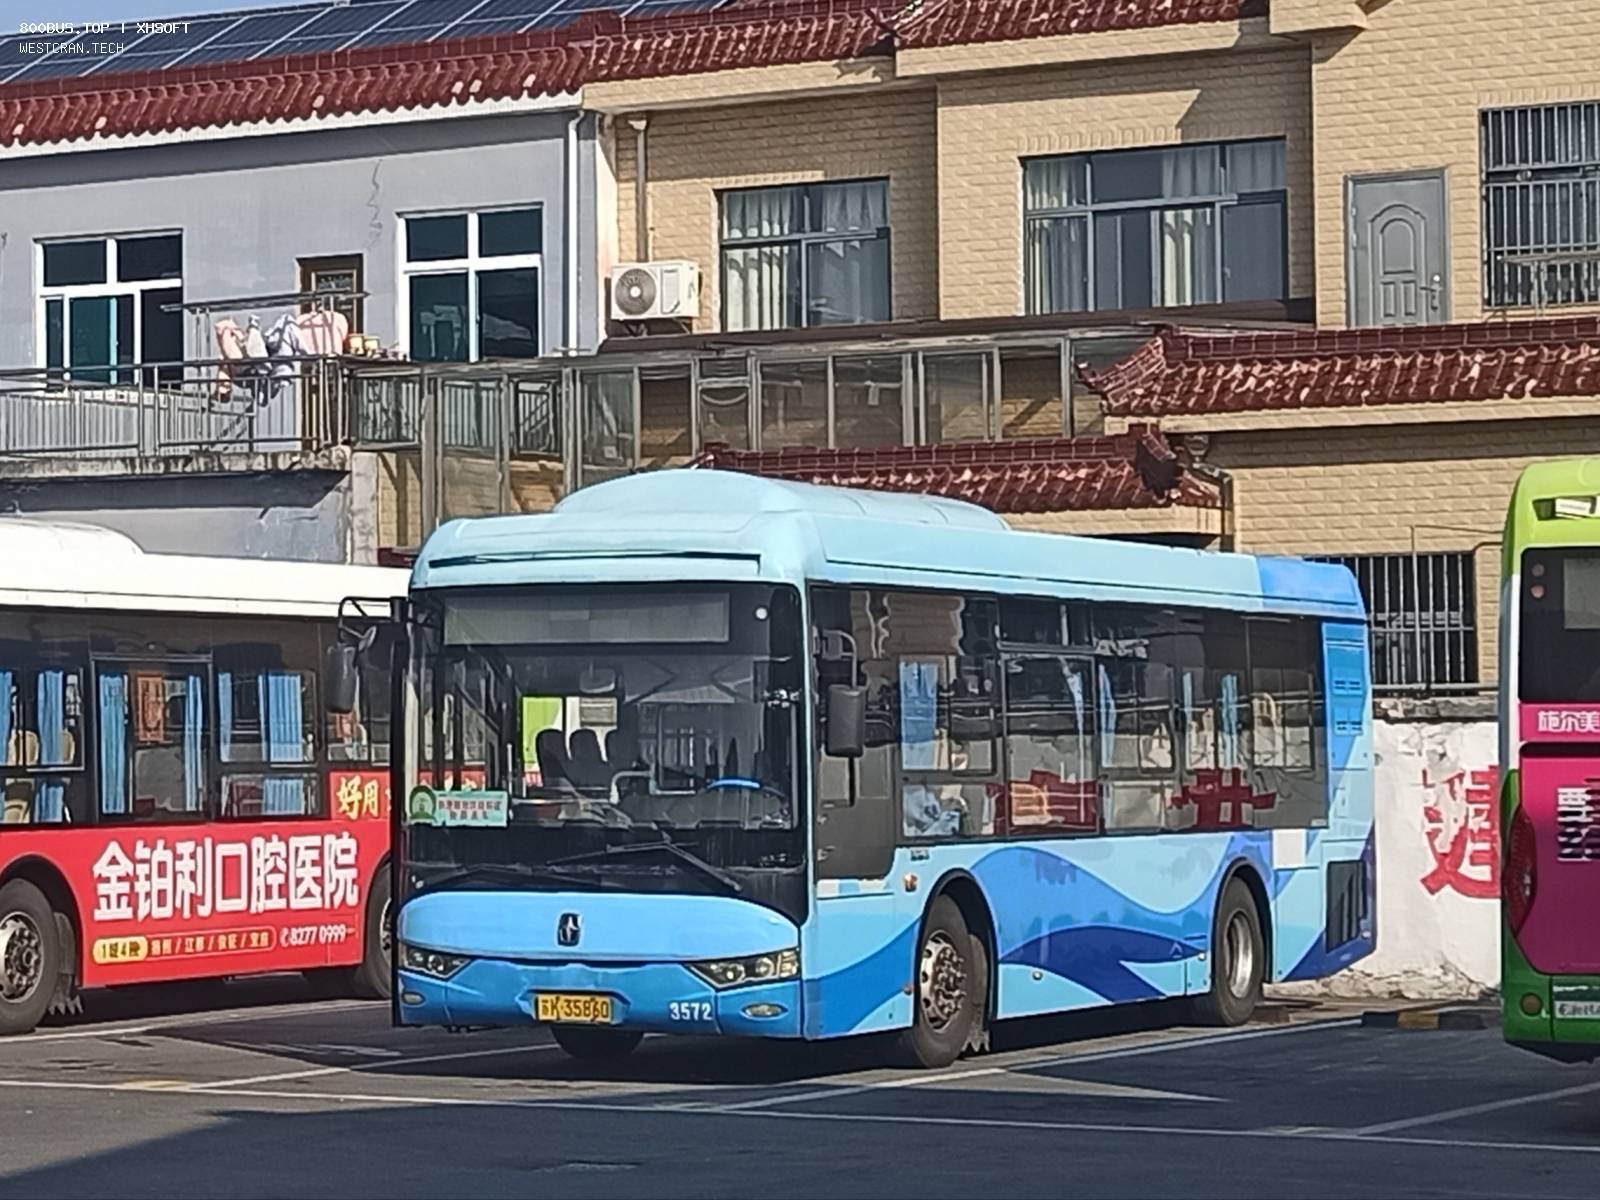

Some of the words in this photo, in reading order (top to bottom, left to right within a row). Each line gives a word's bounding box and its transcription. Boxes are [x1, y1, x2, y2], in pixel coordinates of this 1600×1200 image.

[336, 775, 391, 820] 好用
[92, 831, 359, 922] 金铂利口腔医院
[669, 1002, 713, 1020] 3572
